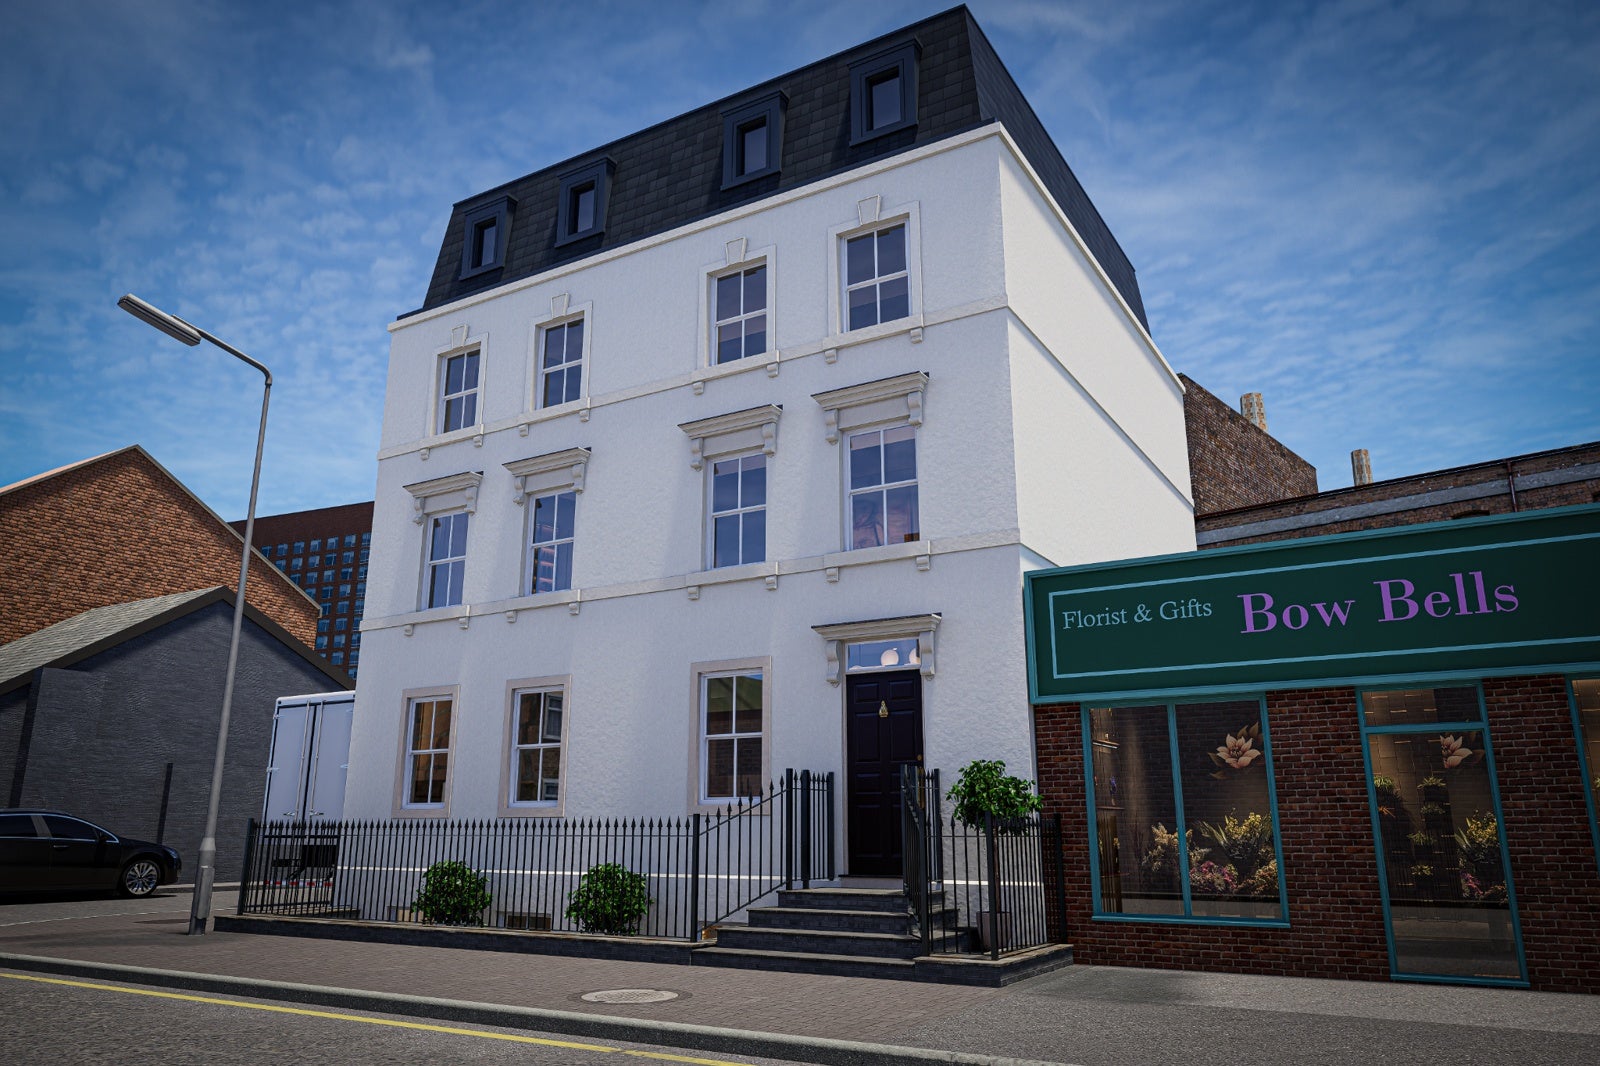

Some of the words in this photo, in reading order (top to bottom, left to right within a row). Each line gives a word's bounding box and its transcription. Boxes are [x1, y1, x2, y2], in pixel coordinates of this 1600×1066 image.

[1061, 608, 1128, 629] Florist
[1133, 603, 1153, 623] &
[1159, 598, 1213, 621] Gifts
[1237, 592, 1356, 634] Bow
[1373, 570, 1520, 623] Bells
